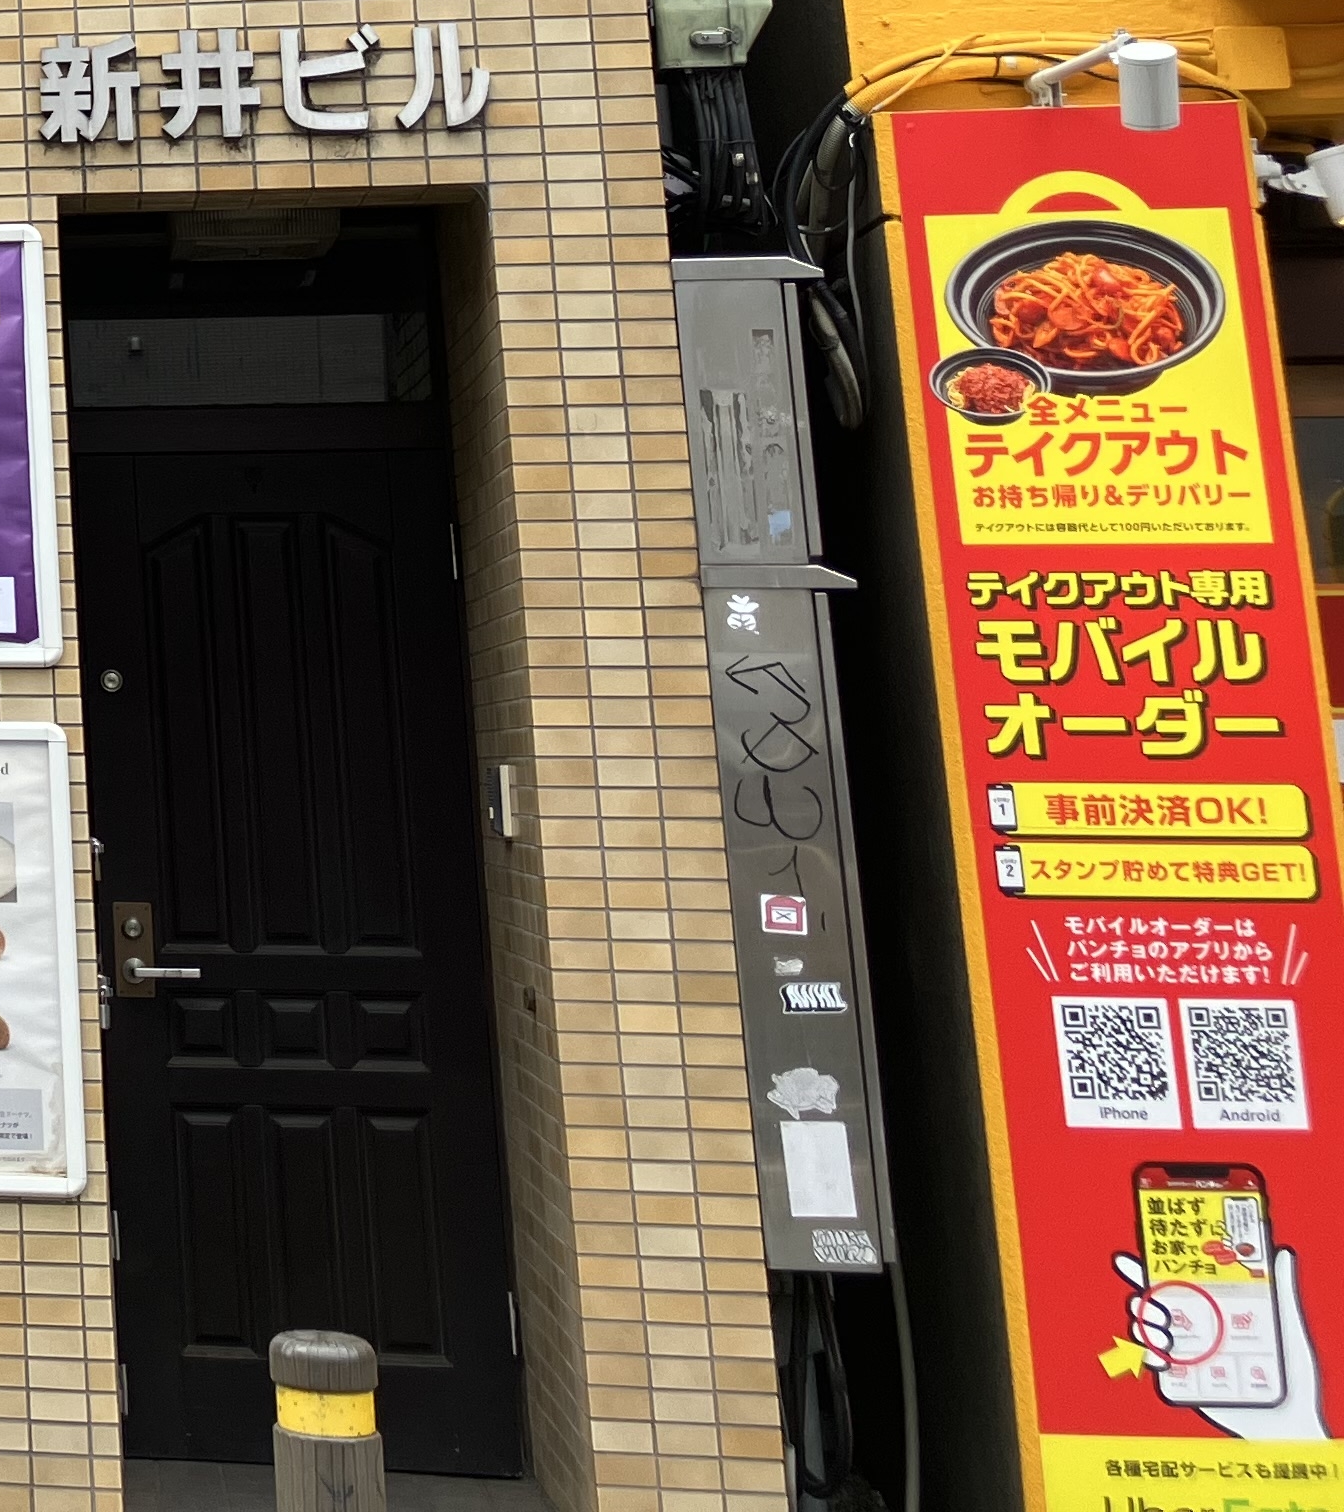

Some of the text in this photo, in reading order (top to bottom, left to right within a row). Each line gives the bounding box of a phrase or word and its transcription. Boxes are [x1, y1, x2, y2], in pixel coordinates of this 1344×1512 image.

[38, 22, 491, 144] 新井ビル
[1028, 395, 1188, 426] 全メニュー
[964, 428, 1248, 478] テイクアウト
[972, 483, 1251, 509] お持ち帰り&デリバリー
[974, 521, 1252, 534] テイクアウトには容器代として100円いただいております。
[965, 569, 1271, 610] テイクアウト専用
[974, 615, 1269, 685] モバイル
[983, 688, 1286, 761] オーダー
[998, 803, 1005, 816] 1
[1005, 864, 1014, 878] 2
[1063, 915, 1257, 937] モバイルオーダーは
[1099, 1104, 1281, 1123] iPhone Android
[1147, 1196, 1205, 1216] 並ばず
[1149, 1218, 1224, 1237] 待たずに
[1151, 1239, 1199, 1256] お家で
